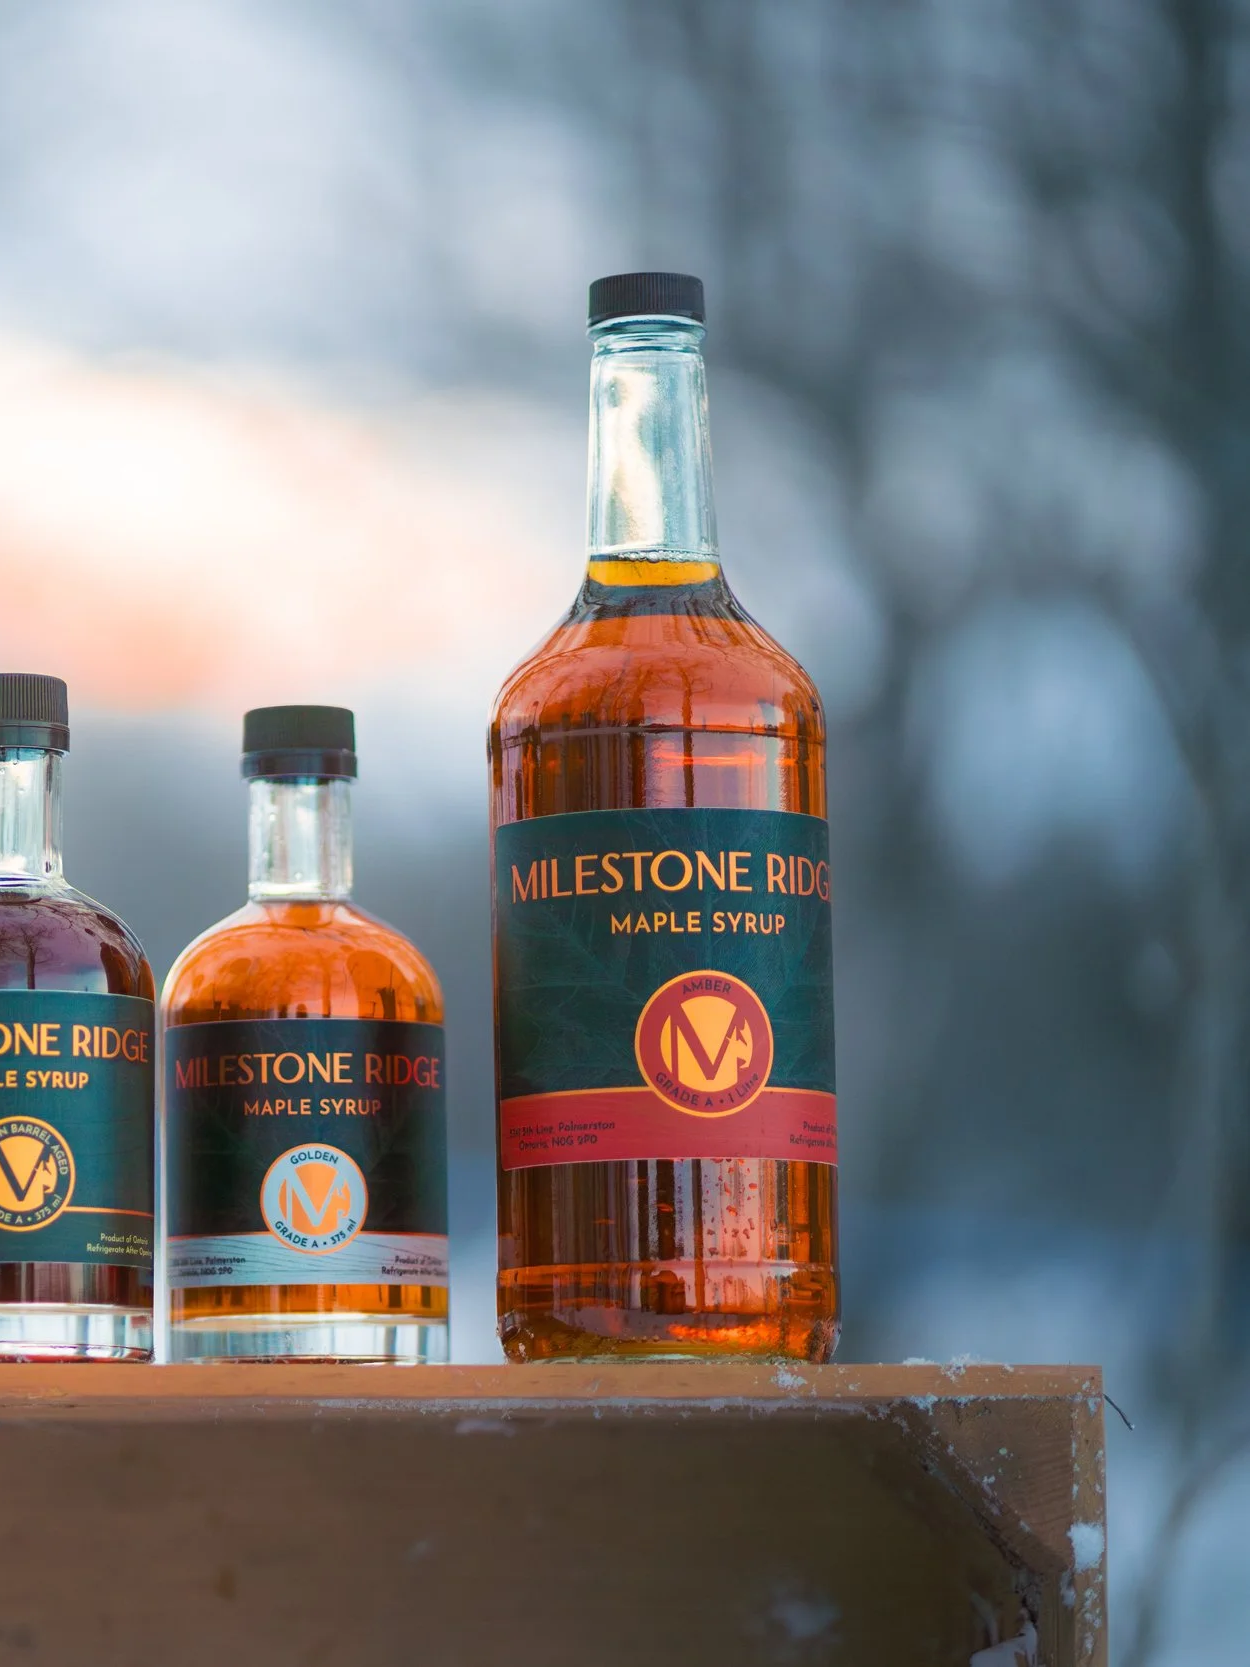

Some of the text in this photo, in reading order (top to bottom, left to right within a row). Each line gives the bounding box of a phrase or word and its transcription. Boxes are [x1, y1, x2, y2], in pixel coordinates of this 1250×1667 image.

[511, 850, 830, 903] MILESTONE RIDG
[611, 912, 786, 935] MAPLE SYRUP
[683, 979, 731, 995] AMBER
[72, 1024, 148, 1063] RIDGE
[25, 1070, 89, 1090] SYRUP
[175, 1052, 440, 1089] MILESTONE RIDGE
[655, 1072, 699, 1105] GRADE
[705, 1097, 713, 1107] A
[243, 1098, 382, 1116] MAPLE SYRUP
[10, 1123, 52, 1145] BARREL
[50, 1144, 69, 1175] AGED
[290, 1150, 339, 1165] GOLDEN
[15, 1215, 23, 1224] A
[34, 1206, 51, 1220] 375
[100, 1232, 124, 1243] Product
[125, 1234, 132, 1244] of
[274, 1218, 357, 1248] GRADE A 375 ml
[86, 1243, 125, 1255] Refrigerate
